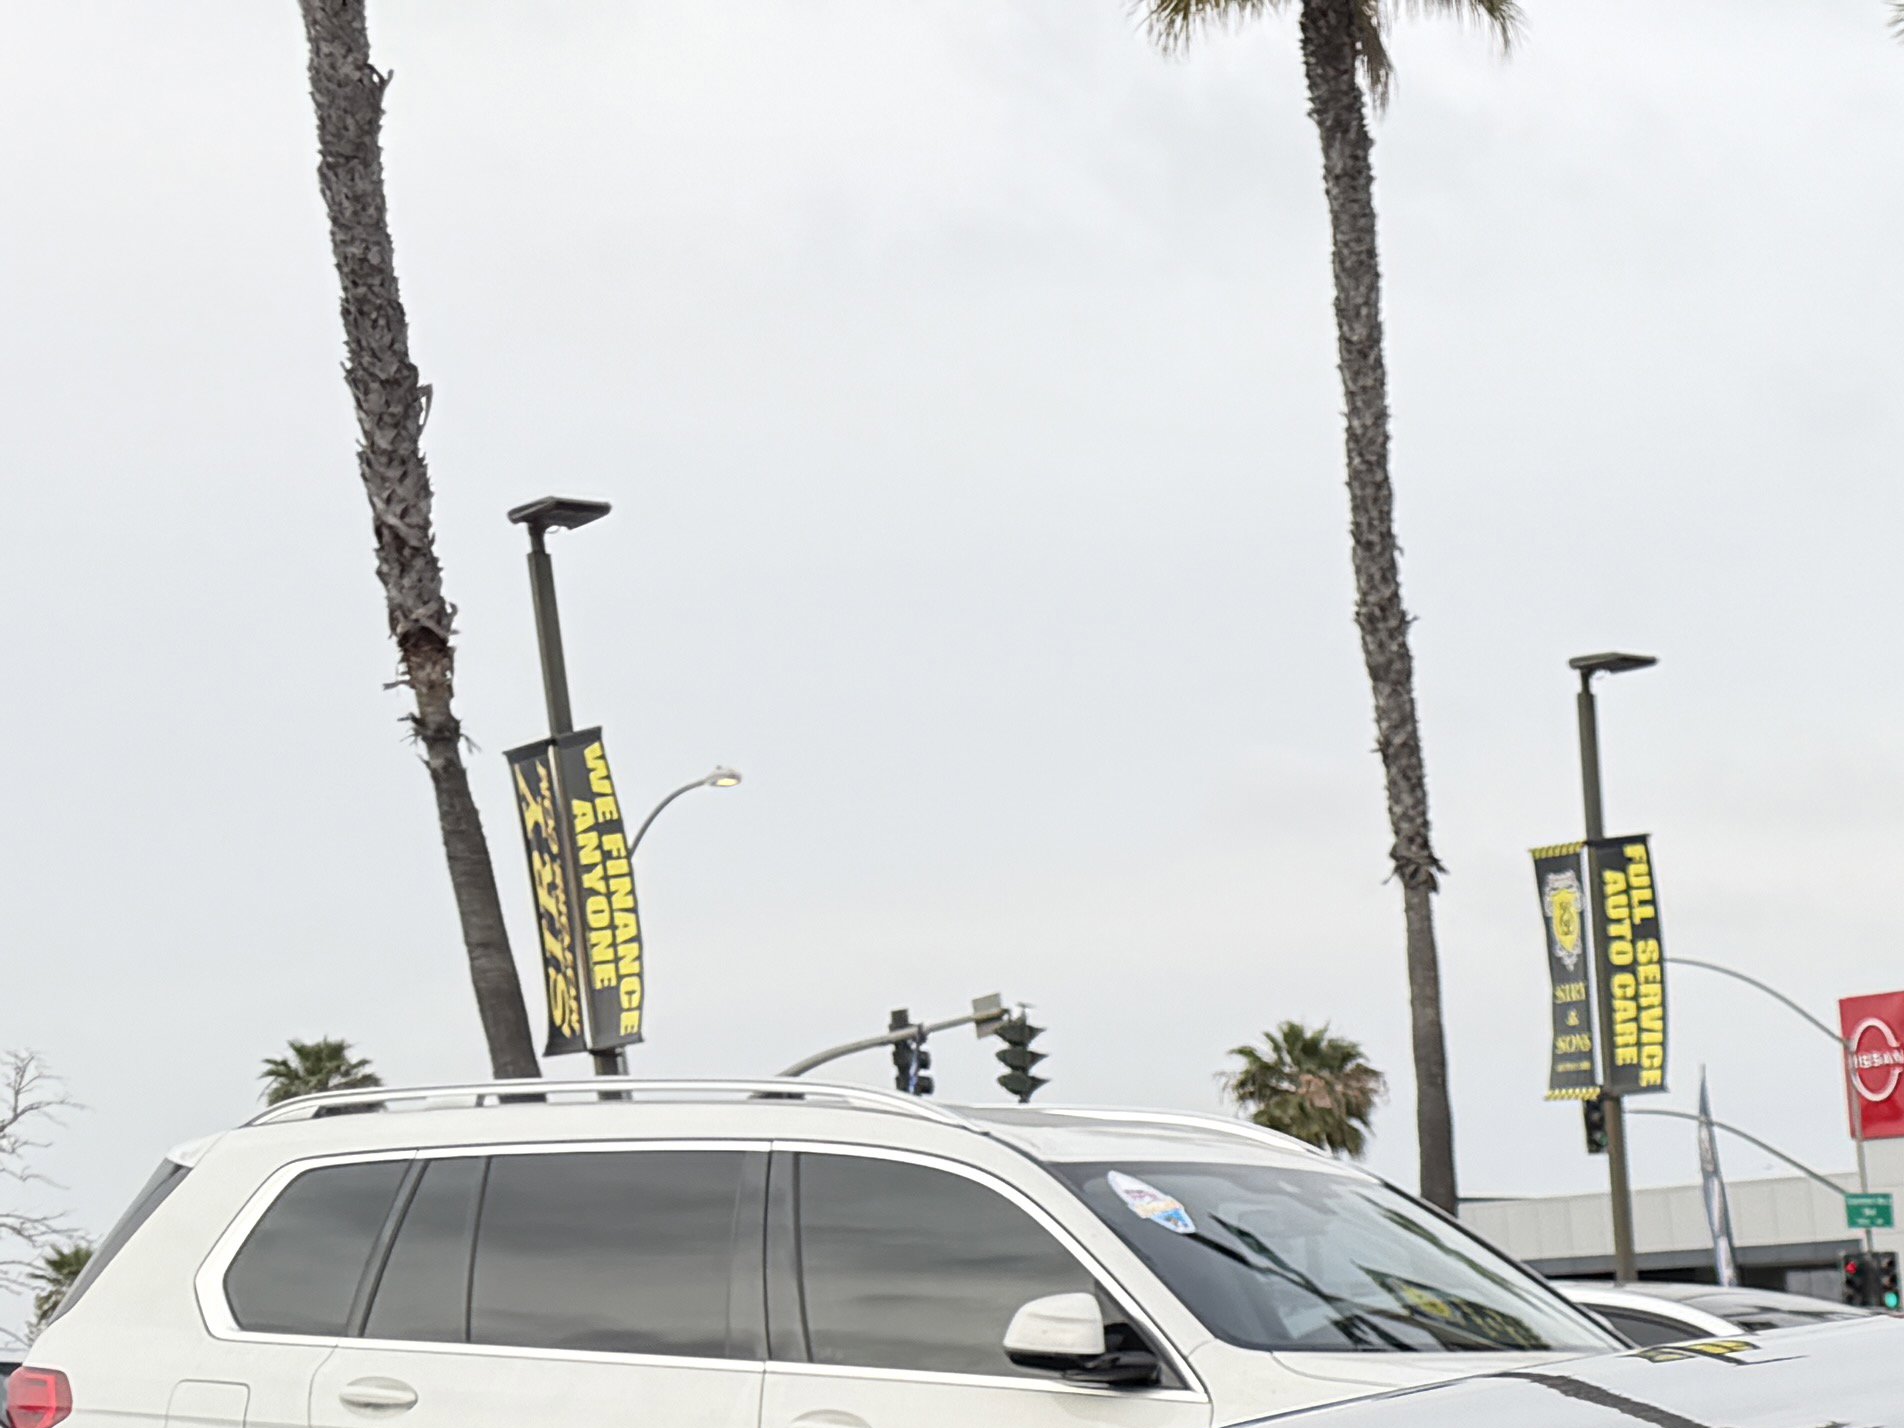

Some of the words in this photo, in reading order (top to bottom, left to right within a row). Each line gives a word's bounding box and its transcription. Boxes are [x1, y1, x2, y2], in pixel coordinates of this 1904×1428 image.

[571, 798, 617, 990] ANYONE
[584, 742, 618, 823] WE
[602, 833, 641, 1036] FINANCE
[1603, 869, 1633, 966] AUTO
[1623, 843, 1655, 925] FULL
[1610, 972, 1638, 1066] CARE
[1636, 938, 1663, 1087] SERVICE
